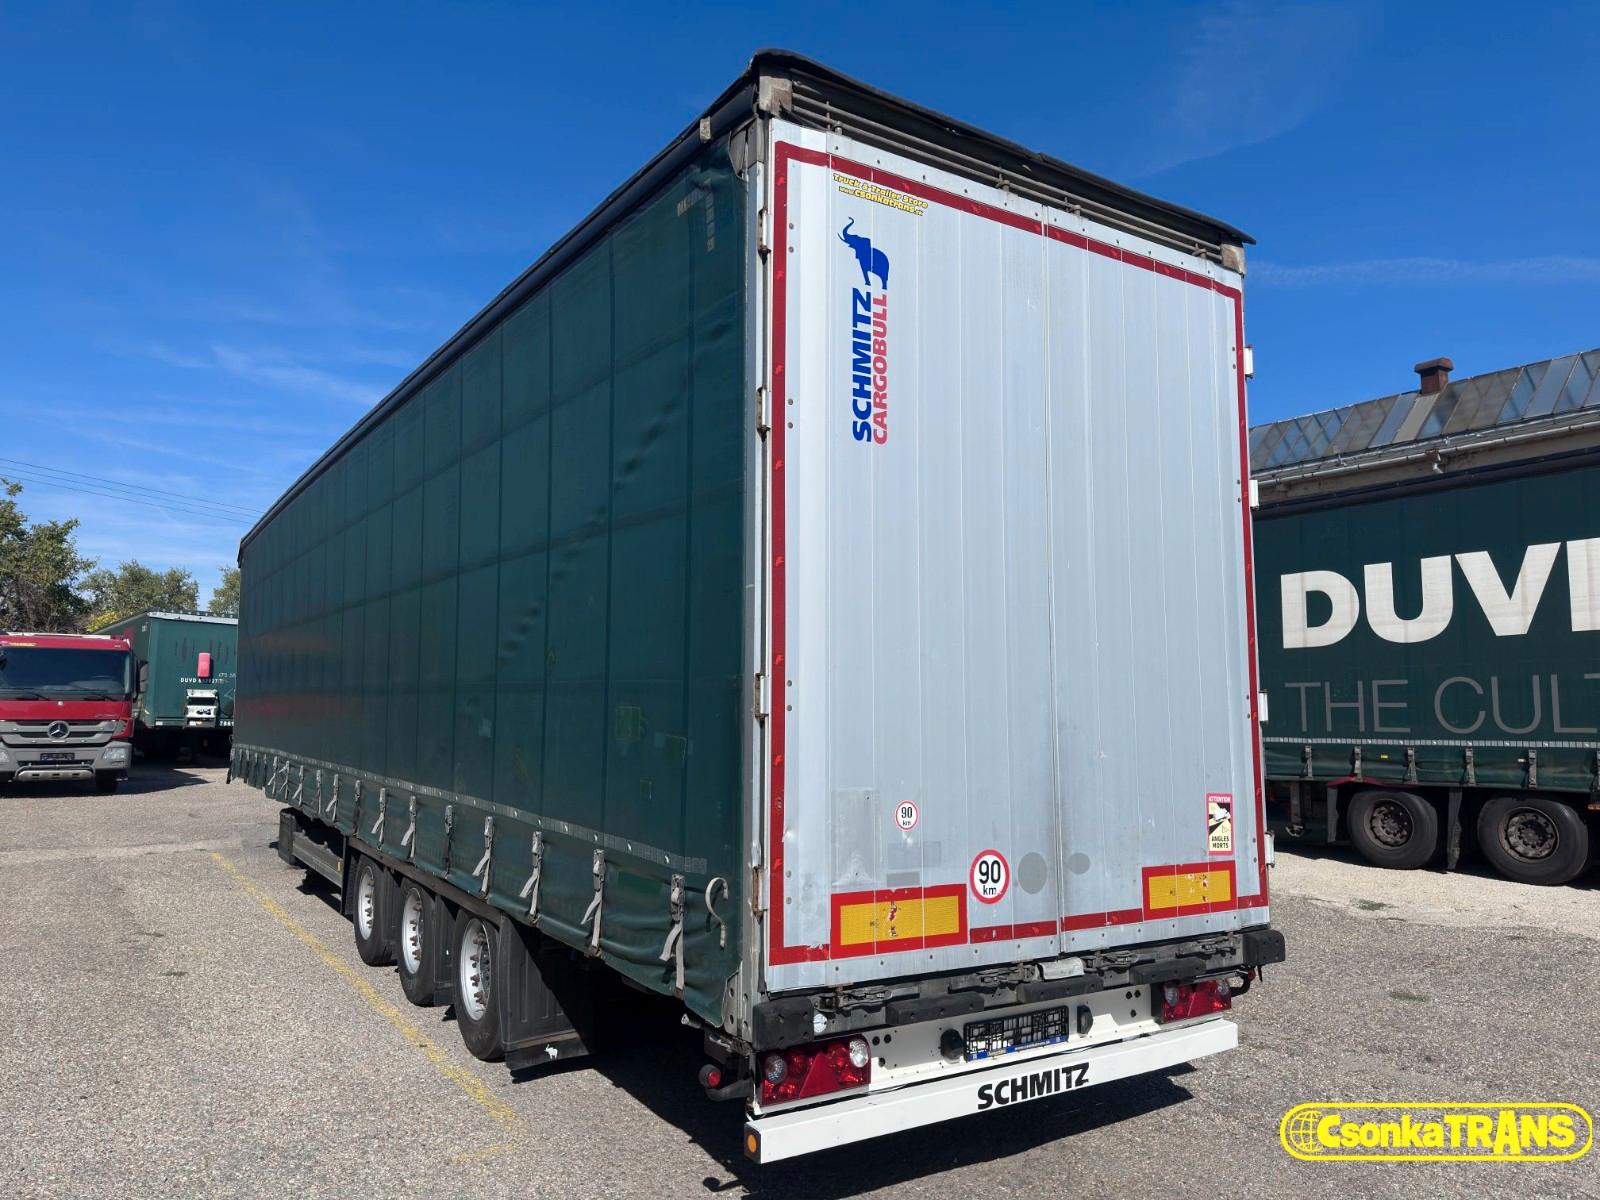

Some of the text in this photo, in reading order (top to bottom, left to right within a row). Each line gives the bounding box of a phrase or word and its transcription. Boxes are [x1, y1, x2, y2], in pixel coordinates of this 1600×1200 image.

[833, 173, 861, 188] Truck
[871, 185, 902, 200] Trailer
[902, 194, 929, 209] Store
[852, 287, 871, 442] SCHMITZ
[873, 294, 887, 445] CARGOBULL
[1285, 673, 1600, 734] THE CUL
[901, 806, 913, 818] 90
[978, 860, 1001, 884] 90
[983, 885, 997, 896] km
[977, 1062, 1090, 1110] SCHMITZ
